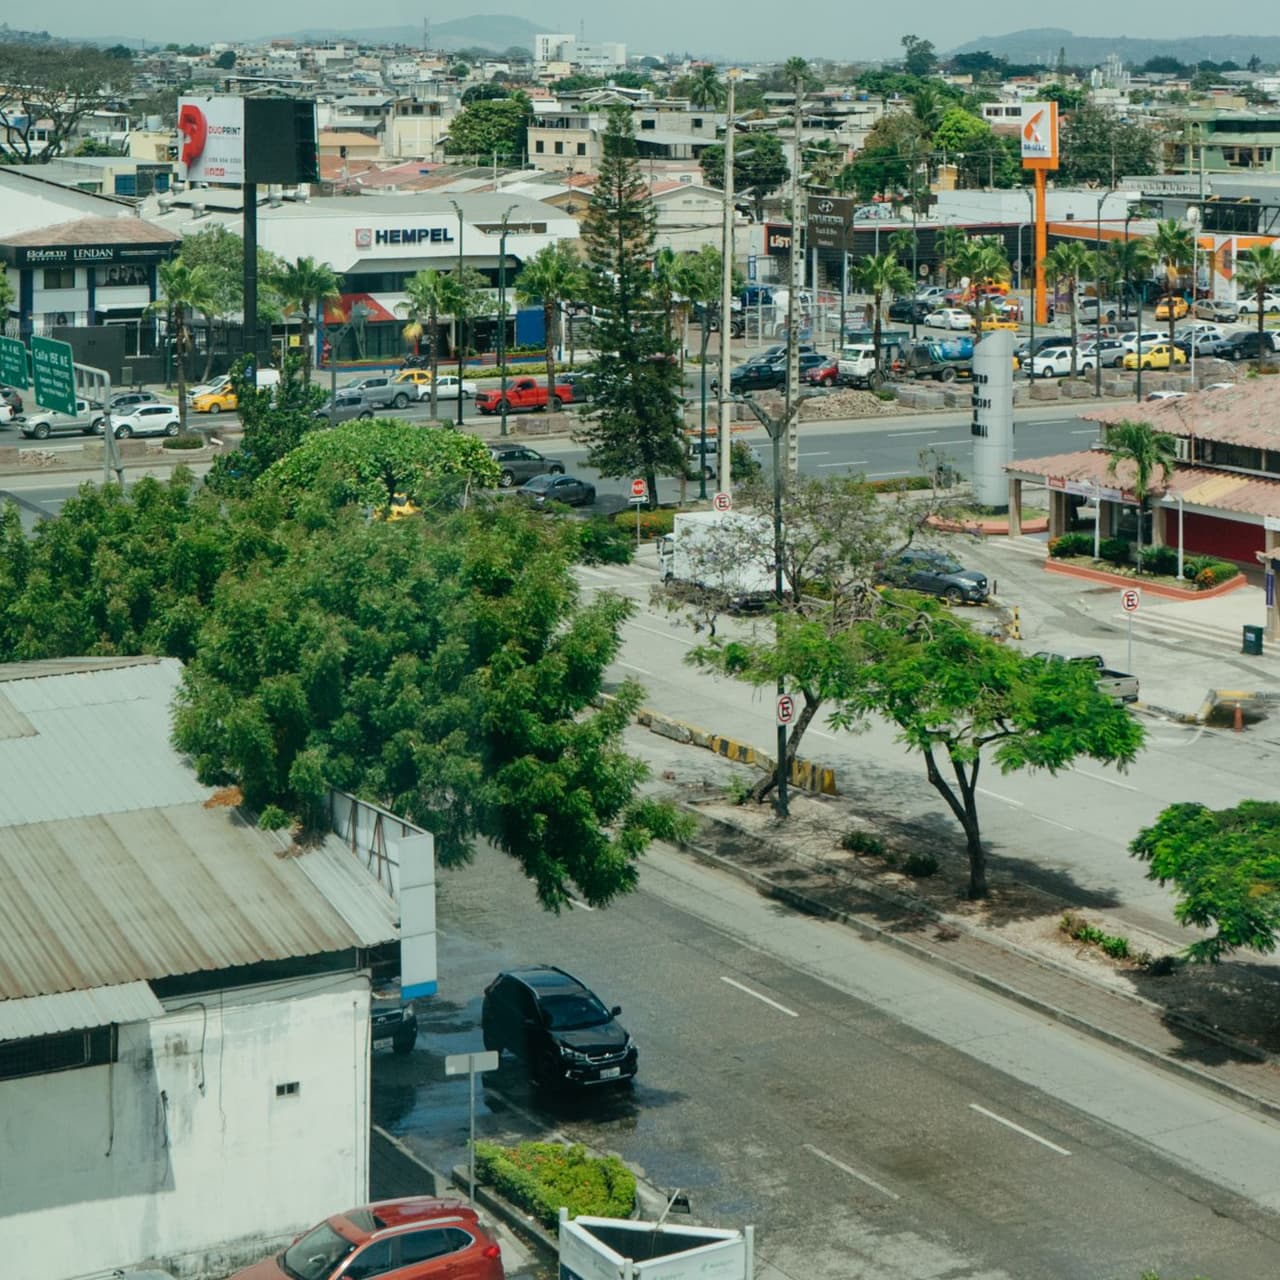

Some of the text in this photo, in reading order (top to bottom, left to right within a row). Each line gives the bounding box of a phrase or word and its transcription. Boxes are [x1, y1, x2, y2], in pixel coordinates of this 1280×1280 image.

[208, 126, 241, 135] DUOPRINT
[375, 228, 454, 244] HEMPEL
[74, 249, 113, 258] LENDAN
[782, 701, 790, 717] E
